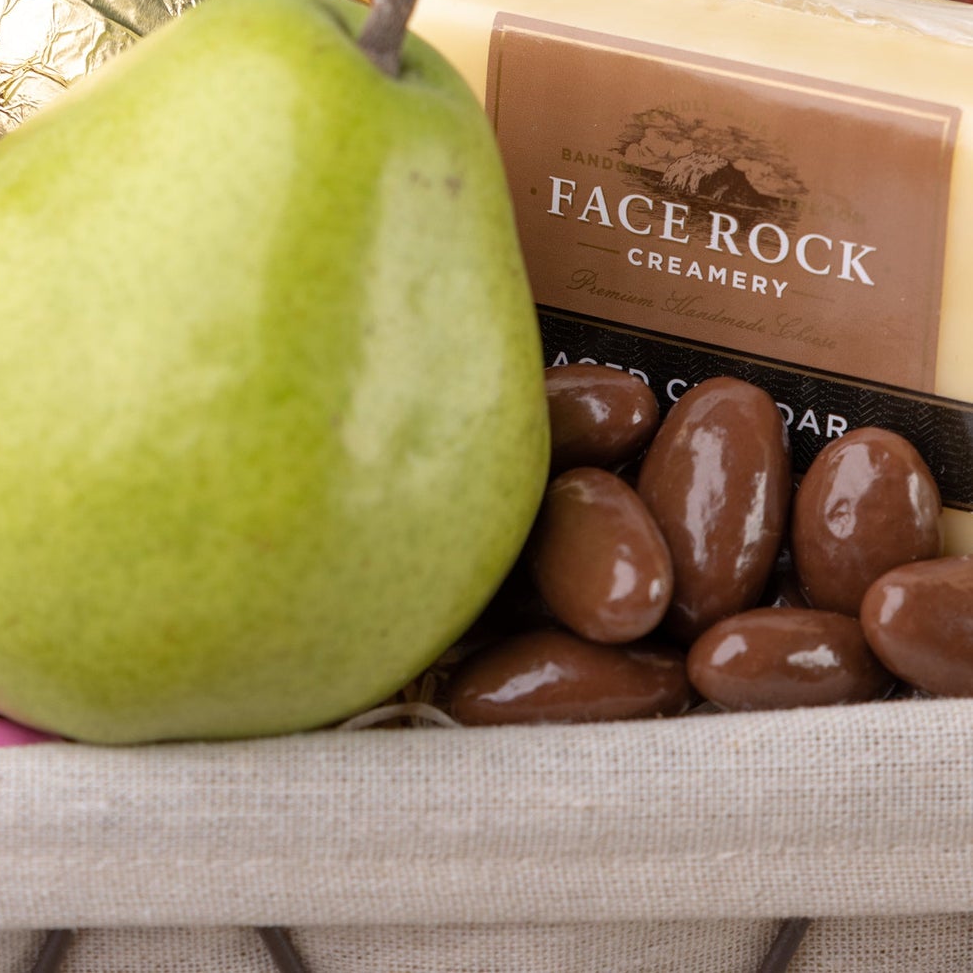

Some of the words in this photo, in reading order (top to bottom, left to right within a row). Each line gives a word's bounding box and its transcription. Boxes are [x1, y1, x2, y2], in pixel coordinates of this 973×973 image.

[546, 175, 690, 245] FACE
[705, 210, 877, 287] ROCK
[565, 268, 655, 308] Premium
[660, 290, 767, 334] Handmade
[626, 247, 789, 299] CREAMERY
